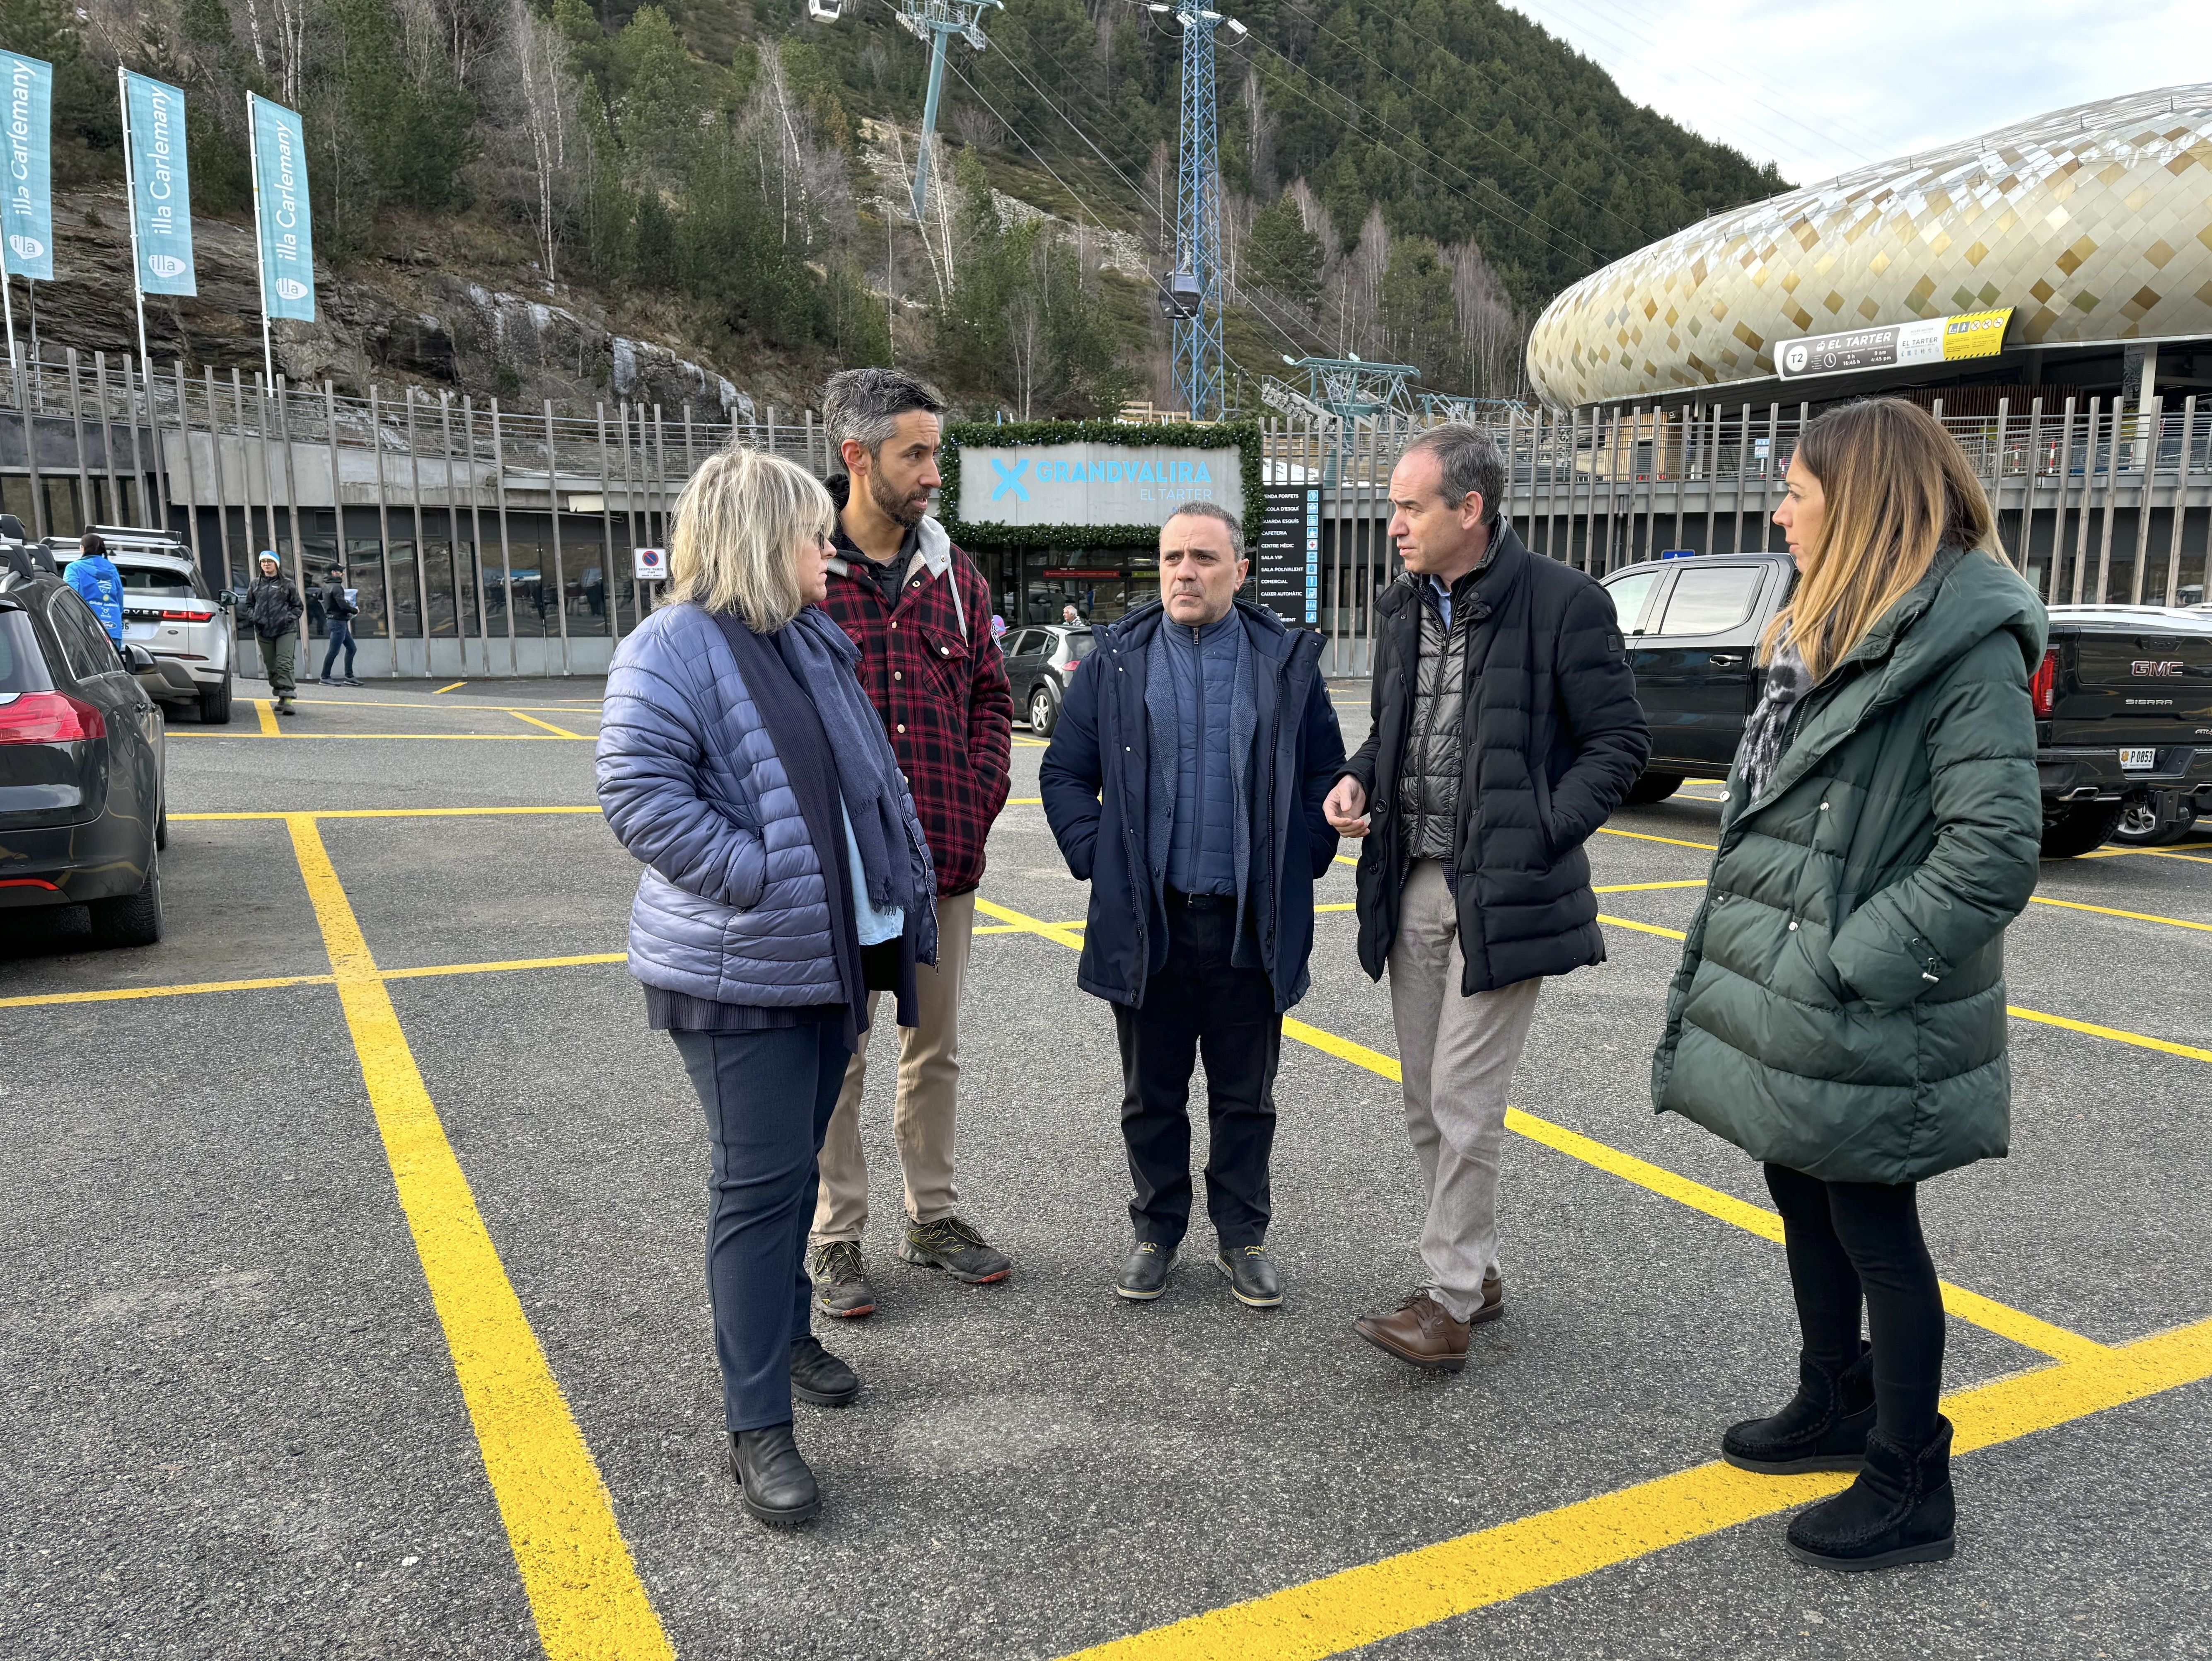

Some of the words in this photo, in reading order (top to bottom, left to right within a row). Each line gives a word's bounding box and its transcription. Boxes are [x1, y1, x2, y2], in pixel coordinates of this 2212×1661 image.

[6, 59, 36, 181] Carlemany
[147, 85, 172, 200] Carlemany
[273, 119, 296, 228] Carlemany
[12, 185, 32, 216] illa
[151, 206, 172, 235] illa
[14, 235, 35, 253] illa
[276, 233, 296, 261] illa
[152, 255, 175, 271] illa
[277, 278, 298, 295] illa
[1828, 339, 1842, 350] EL
[1846, 332, 1892, 347] TARTER
[1912, 336, 1938, 346] TARTER
[1791, 353, 1803, 364] T2
[1036, 460, 1211, 483] GRANDVALIRA
[1140, 488, 1156, 500] EL
[1158, 488, 1212, 500] TARTER
[2131, 661, 2184, 677] GMC
[2130, 751, 2135, 763] P
[2136, 750, 2153, 763] 0853
